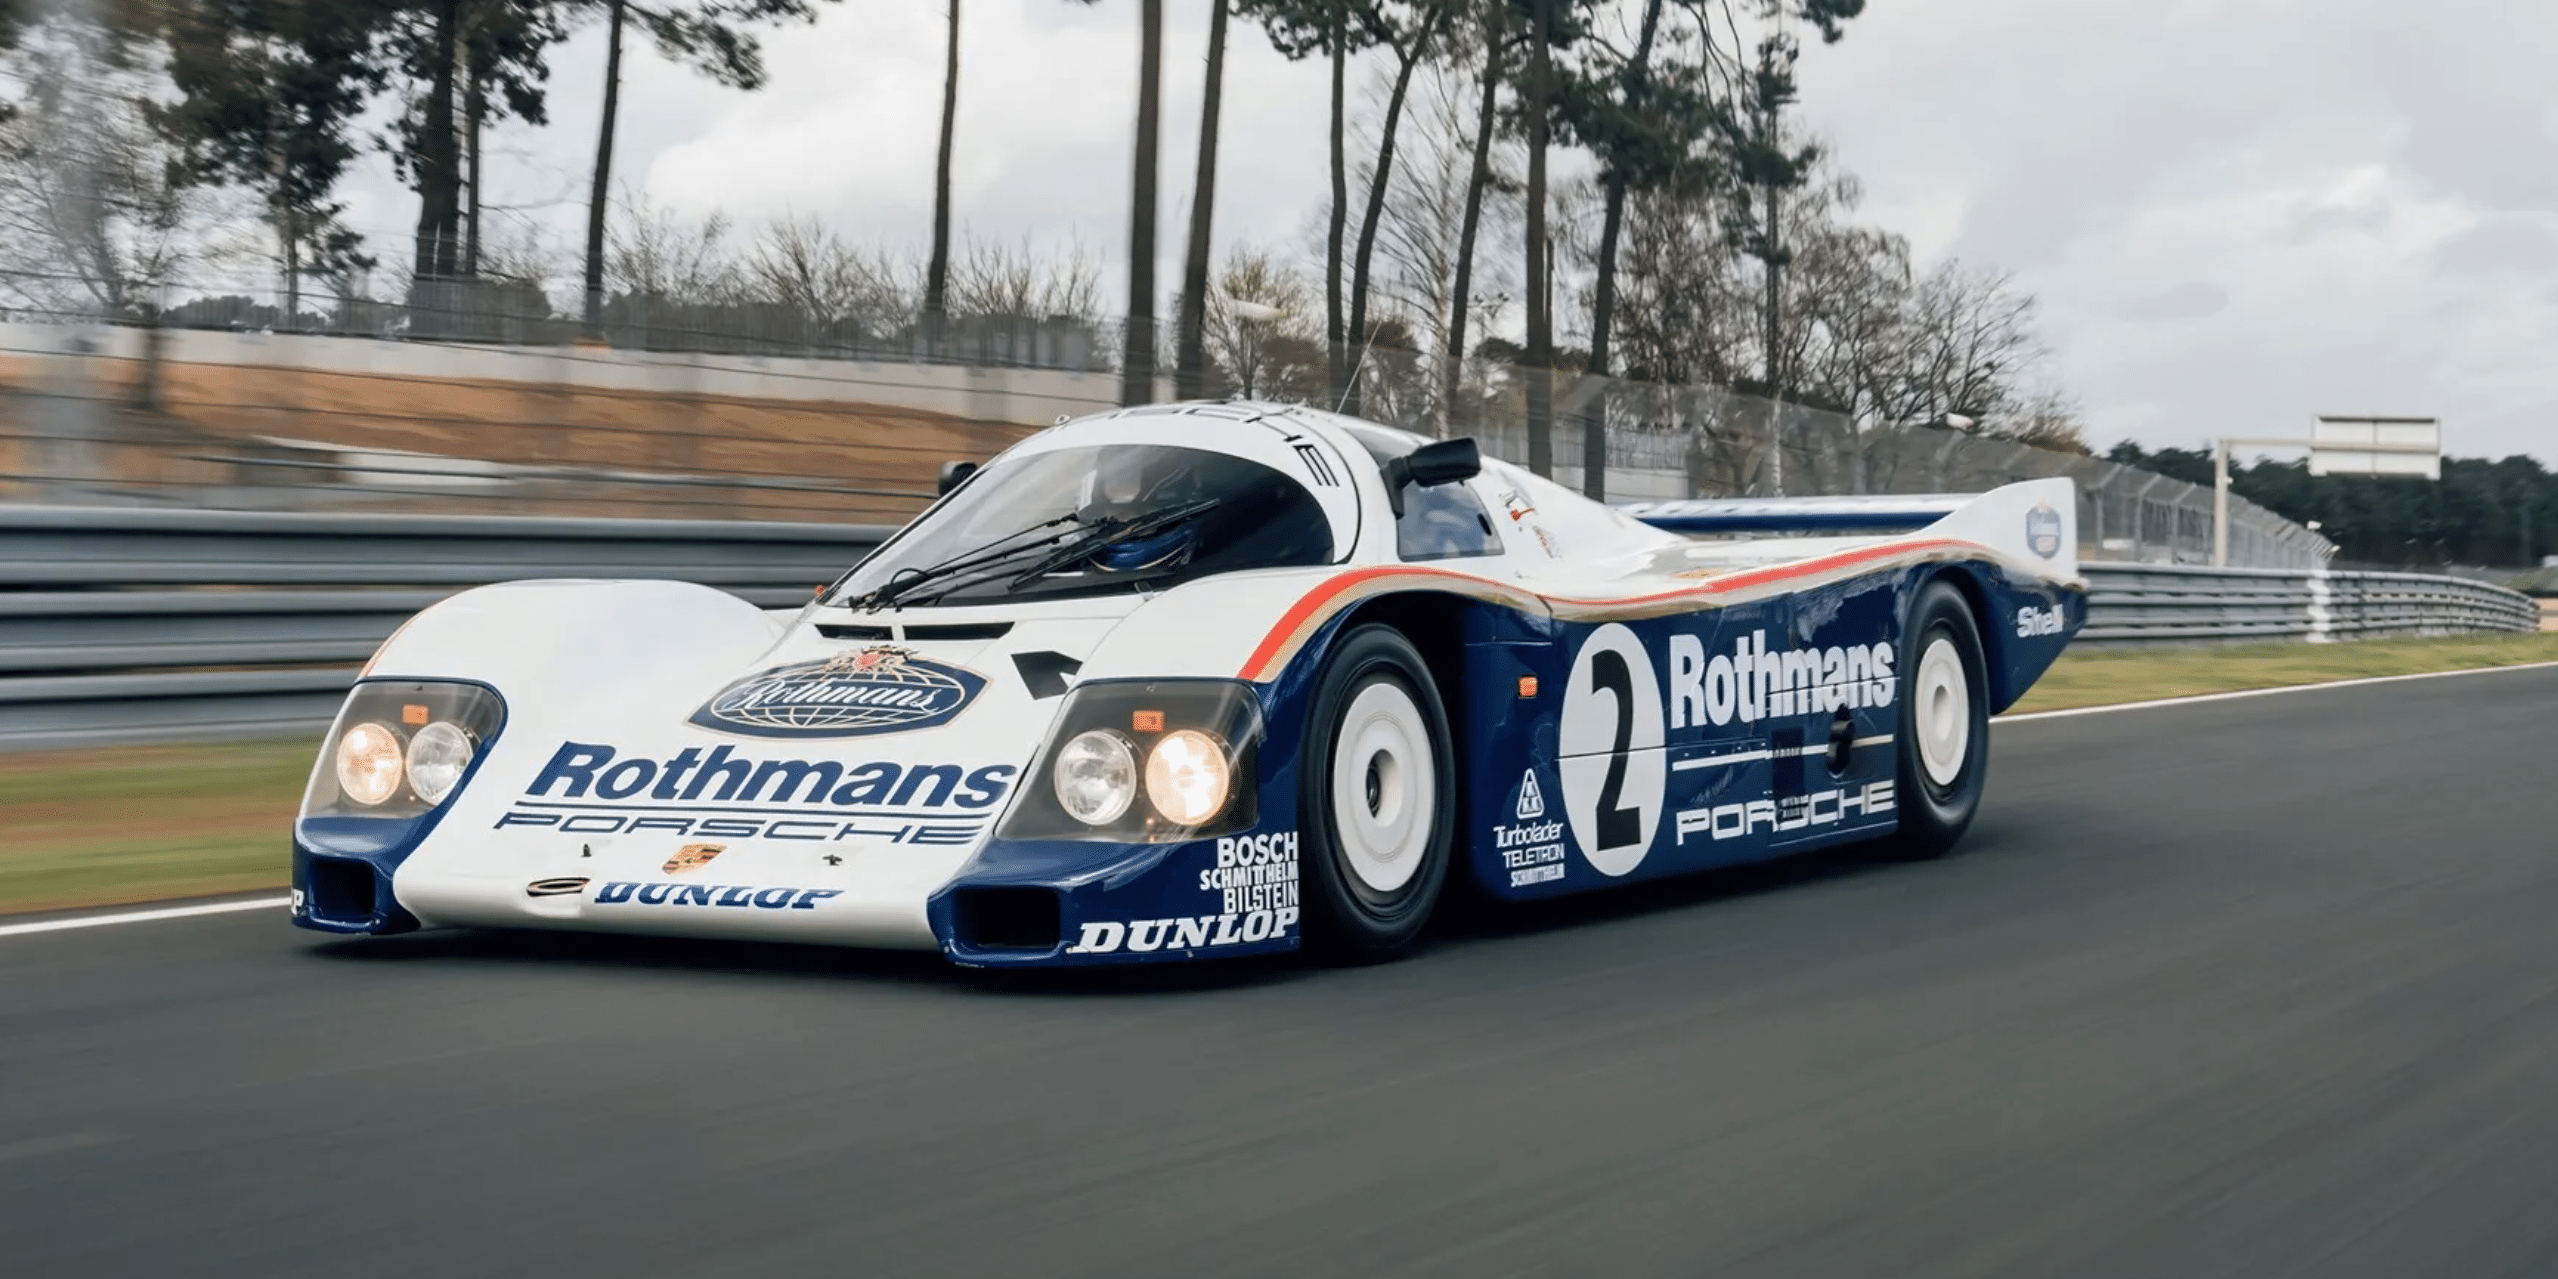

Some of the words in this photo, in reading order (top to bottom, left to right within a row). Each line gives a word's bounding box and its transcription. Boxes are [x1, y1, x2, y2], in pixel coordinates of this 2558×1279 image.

[2017, 603, 2063, 638] Shell
[721, 677, 942, 713] Rothmans
[1669, 629, 1896, 730] Rothmans
[1591, 649, 1642, 852] 2
[525, 741, 1018, 809] Rothmans
[493, 811, 985, 845] PORSCHE
[1676, 779, 1895, 847] PORSCHE
[1217, 831, 1299, 868] BOSCH
[1492, 819, 1564, 848] Turbolader
[594, 881, 846, 911] DUNLOP
[1222, 880, 1299, 914] BILSTEIN
[1065, 906, 1299, 954] DUNLOP
